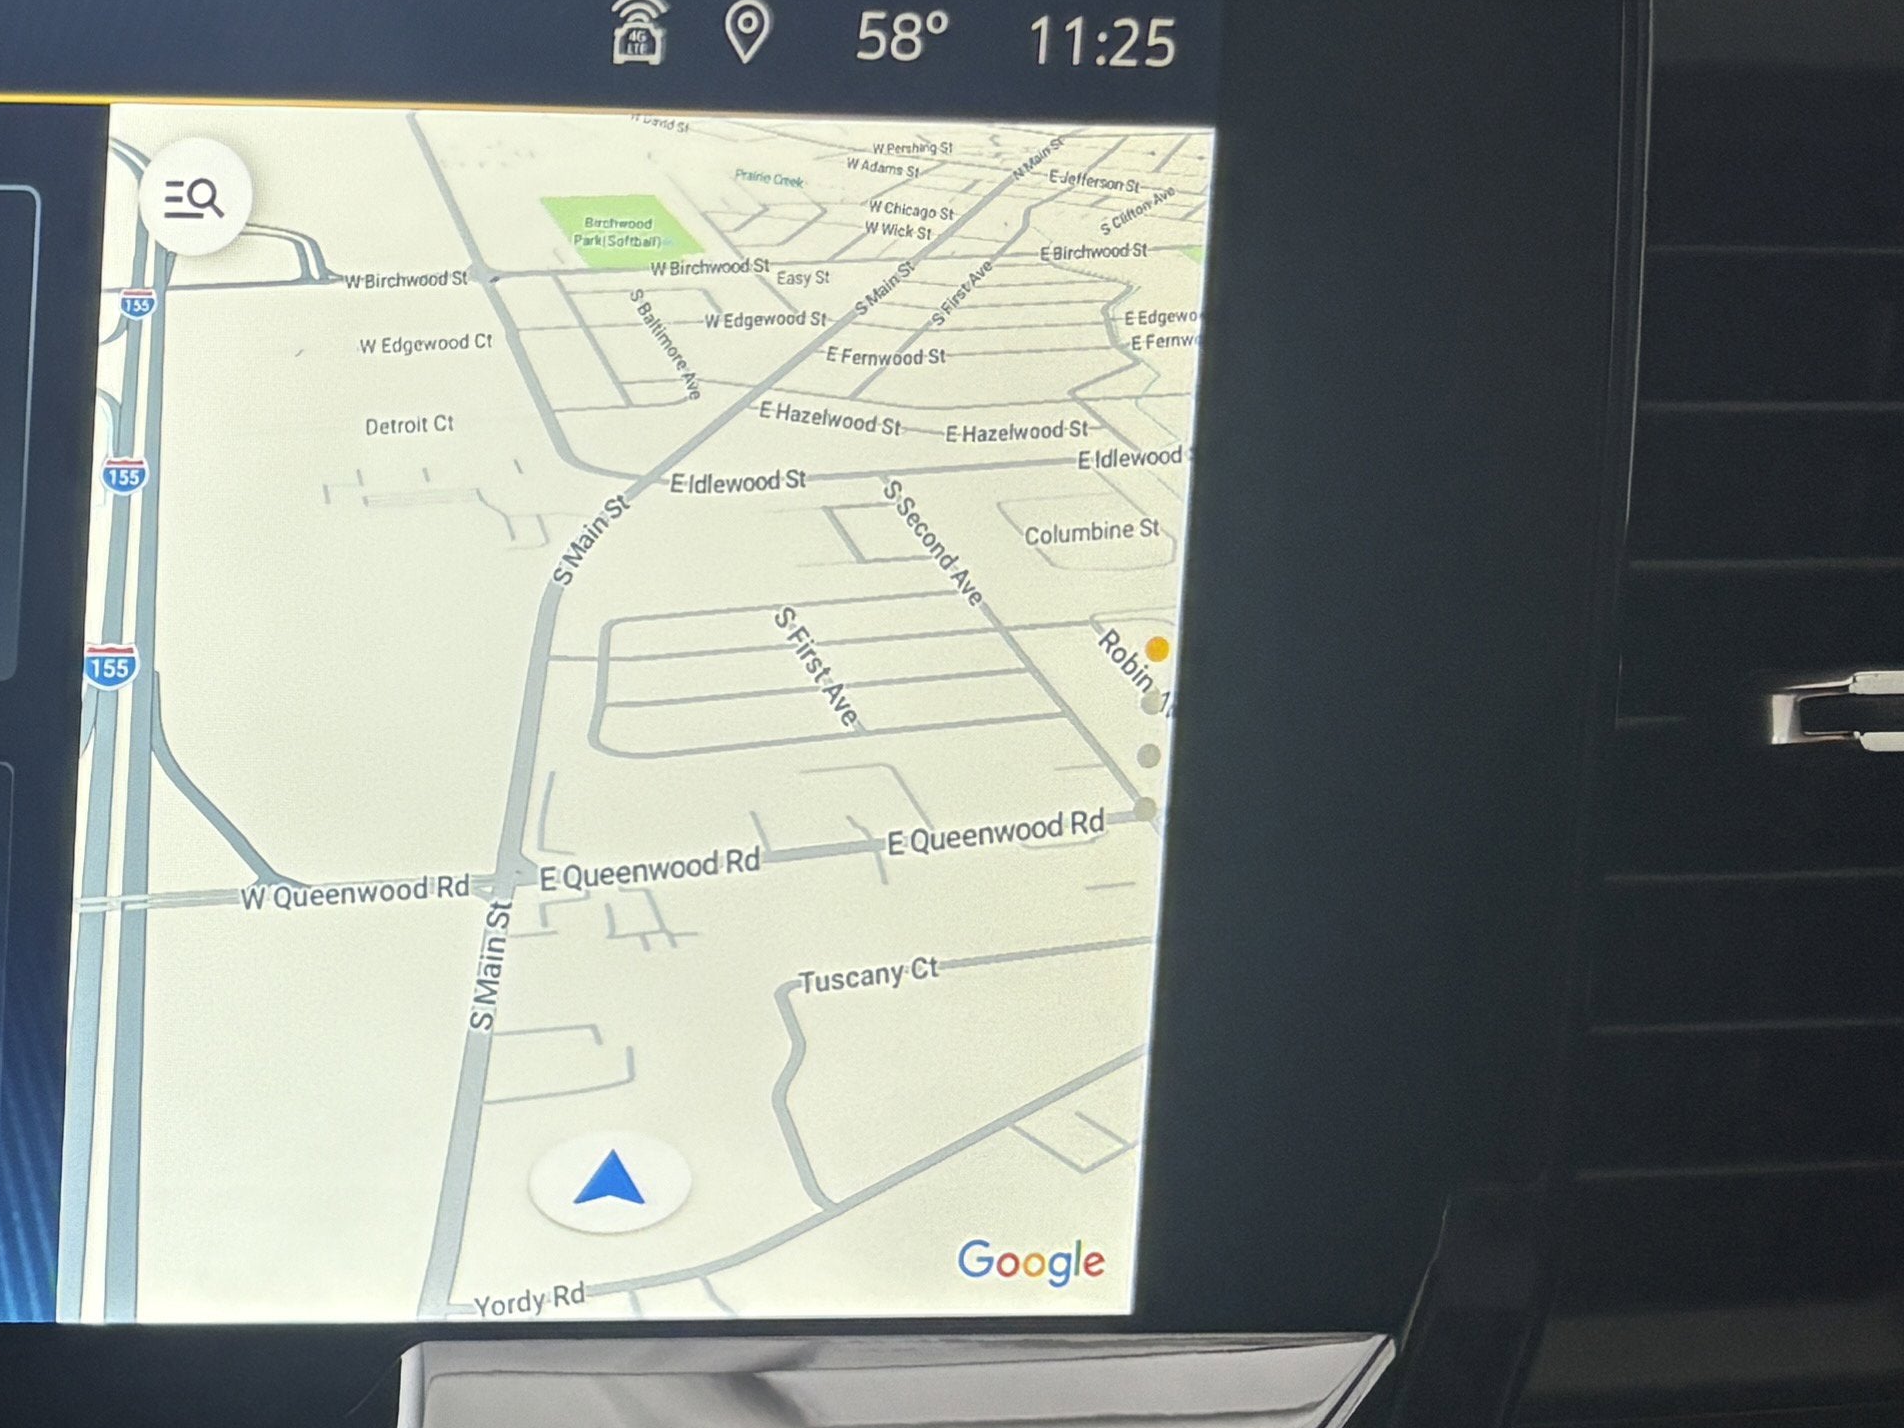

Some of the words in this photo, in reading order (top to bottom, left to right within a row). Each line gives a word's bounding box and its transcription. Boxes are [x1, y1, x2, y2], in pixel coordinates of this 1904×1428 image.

[1031, 15, 1175, 67] 11:25
[860, 159, 903, 176] Adams
[1049, 169, 1059, 184] E
[1060, 170, 1124, 192] Jefferson
[1126, 179, 1141, 194] St
[869, 199, 883, 213] W
[884, 200, 937, 220] Chicago
[940, 207, 954, 221] St
[865, 221, 879, 234] W
[881, 222, 914, 238] Wick
[917, 226, 932, 240] St
[1040, 246, 1050, 262] E
[1052, 243, 1131, 260] Birchwood
[1132, 242, 1148, 258] St
[651, 261, 667, 276] W
[669, 259, 750, 276] Birchwood
[753, 258, 770, 273] St
[776, 271, 812, 287] Easy
[815, 270, 830, 284] St
[344, 272, 363, 290] W
[365, 270, 449, 290] Birchwood
[451, 270, 469, 287] St
[855, 301, 869, 316] S
[865, 275, 901, 306] Main
[898, 260, 916, 279] St
[931, 311, 946, 327] S
[942, 284, 972, 315] First
[968, 260, 993, 288] Ave
[705, 313, 720, 329] W
[723, 311, 806, 332] Edgewood
[810, 311, 827, 328] St
[1125, 311, 1135, 326] E
[1138, 309, 1202, 327] Edgewo
[360, 337, 378, 355] W
[381, 333, 471, 357] Edgewood
[473, 332, 493, 350] Ct
[630, 288, 644, 302] S
[637, 301, 687, 371] Baltimore
[681, 371, 701, 401] Ave
[1131, 335, 1142, 351] E
[826, 346, 838, 362] E
[841, 347, 924, 367] Fernwood
[927, 348, 947, 365] St
[365, 415, 428, 436] Detroit
[432, 414, 455, 433] Ct
[759, 401, 772, 418] E
[775, 402, 877, 433] Hazelwood
[880, 416, 902, 437] St
[946, 425, 958, 444] E
[961, 421, 1064, 444] Hazelwood
[1067, 420, 1090, 438] St
[1078, 450, 1091, 469] E
[1094, 444, 1183, 468] Idlewood
[108, 469, 140, 485] 155
[670, 473, 685, 493] E
[689, 469, 781, 494] Idlewood
[785, 468, 807, 489] St
[603, 494, 631, 520] St
[562, 513, 609, 569] Main
[884, 479, 903, 500] S
[896, 496, 959, 572] Second
[950, 567, 984, 607] Ave
[1024, 520, 1135, 546] Columbine
[1138, 518, 1160, 539] St
[553, 567, 573, 586] S
[92, 658, 129, 678] 155
[774, 606, 795, 628] S
[786, 626, 832, 685] First
[821, 682, 857, 727] Ave
[1098, 627, 1154, 694] Robin
[888, 831, 905, 856] E
[910, 811, 1064, 856] Queenwood
[1070, 807, 1105, 836] Rd
[540, 867, 557, 891] E
[562, 850, 720, 890] Queenwood
[726, 846, 761, 872] Rd
[241, 887, 265, 910] W
[273, 875, 429, 910] Queenwood
[437, 873, 471, 898] Rd
[485, 900, 513, 930] St
[472, 936, 507, 1007] Main
[798, 962, 906, 995] Tuscany
[910, 955, 940, 980] Ct
[469, 1010, 493, 1032] S
[957, 1239, 1106, 1288] Google
[473, 1290, 546, 1320] Yordy
[552, 1281, 587, 1309] Rd
